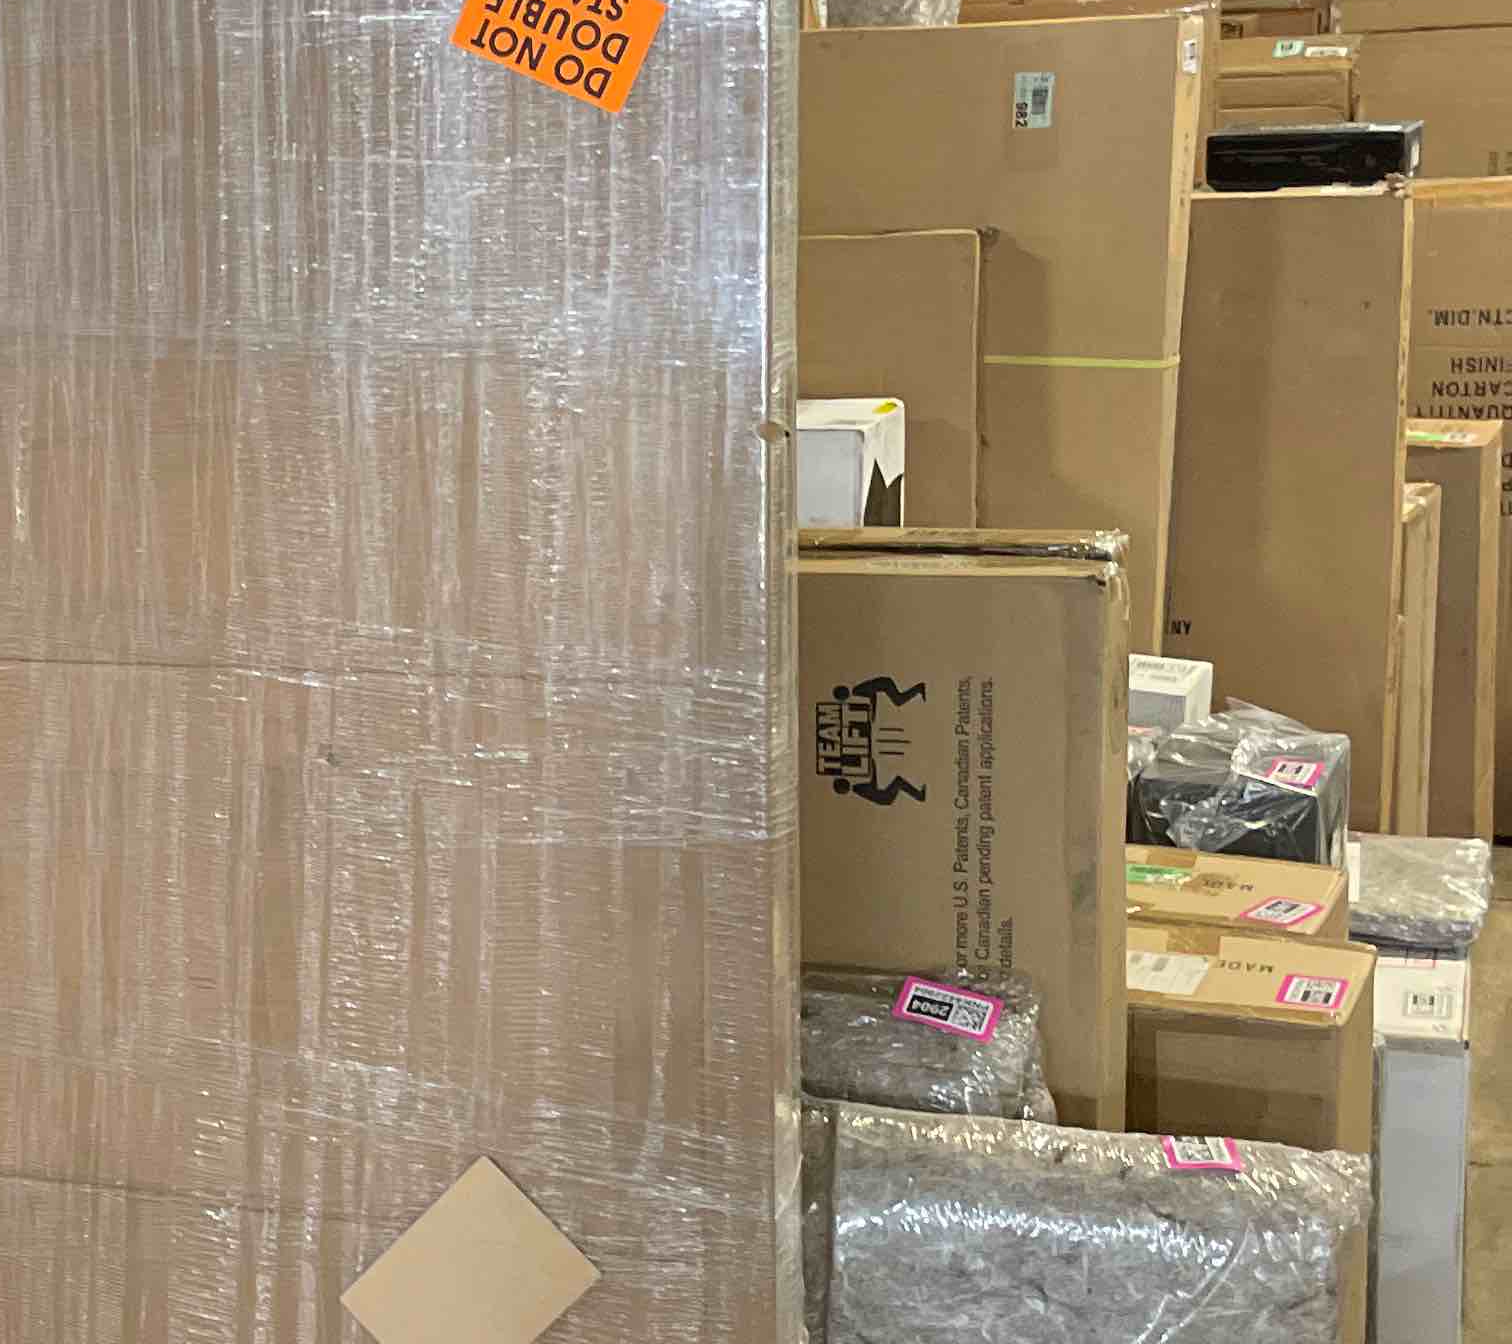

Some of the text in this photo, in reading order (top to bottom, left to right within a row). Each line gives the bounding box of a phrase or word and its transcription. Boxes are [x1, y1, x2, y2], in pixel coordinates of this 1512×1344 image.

[470, 18, 612, 99] DO NOT
[817, 704, 841, 776] TEAM
[841, 703, 871, 776] LIFT
[953, 739, 969, 810] Canadian
[978, 771, 994, 822] patent
[976, 824, 995, 885] pending
[955, 912, 968, 949] more
[974, 888, 991, 961] Canadian
